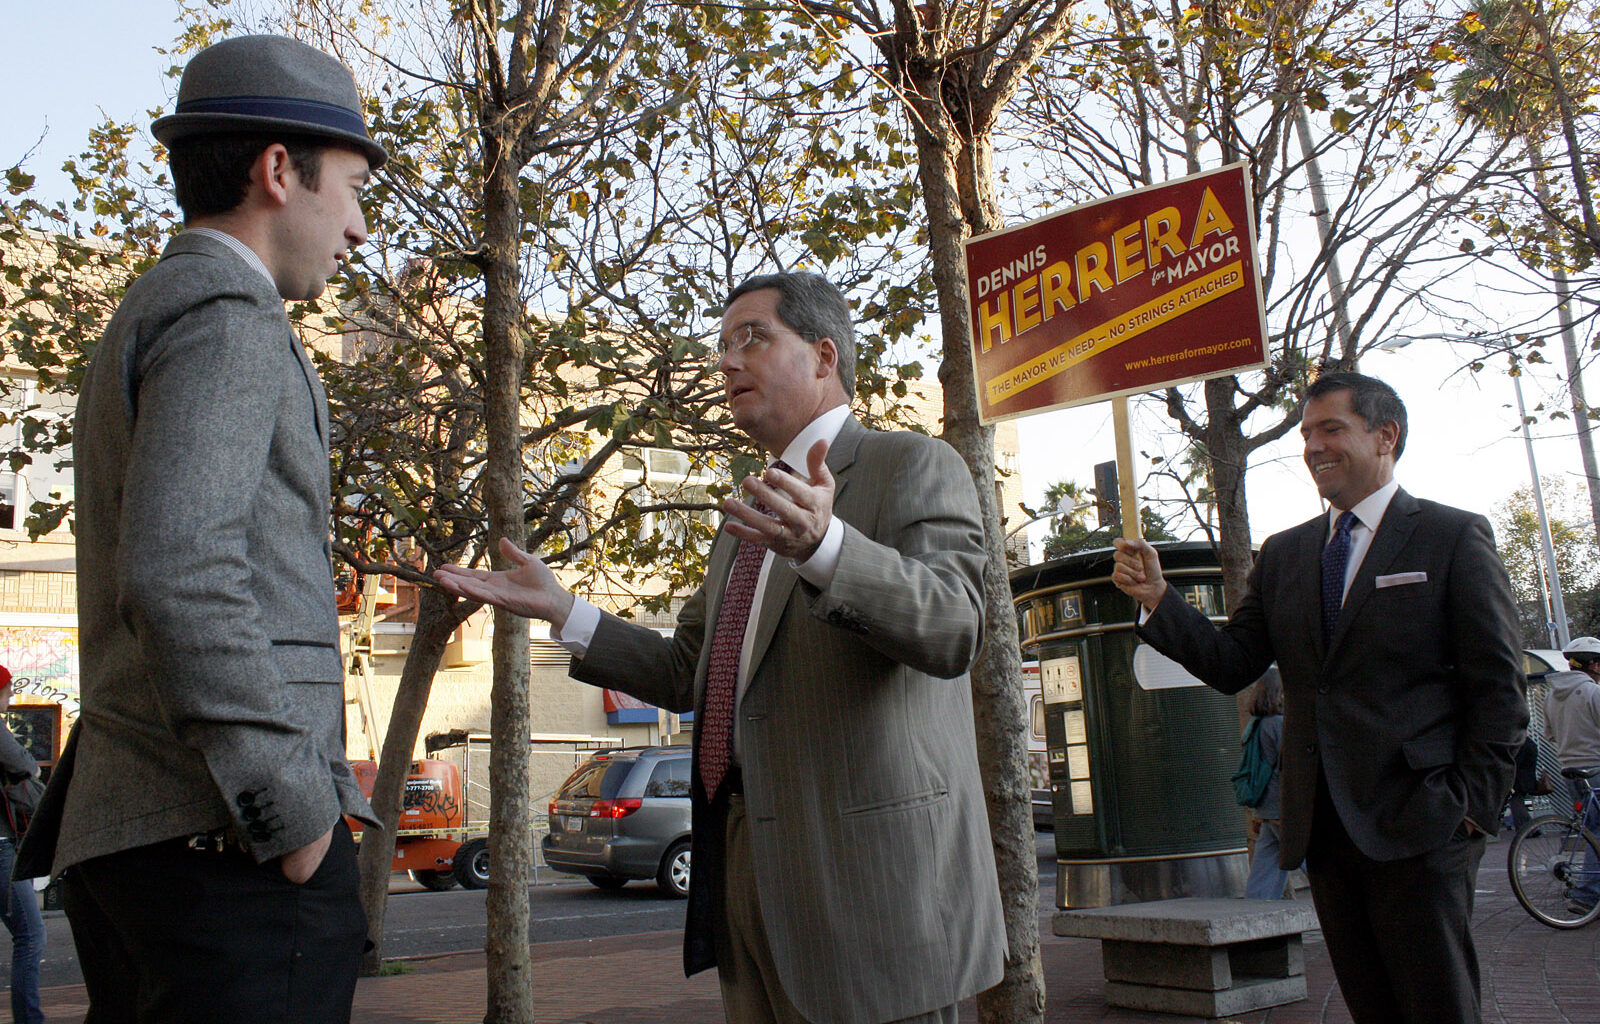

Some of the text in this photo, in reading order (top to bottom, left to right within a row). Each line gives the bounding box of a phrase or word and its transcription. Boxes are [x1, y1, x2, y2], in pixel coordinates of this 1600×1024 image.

[977, 245, 1047, 299] DENNIS
[978, 186, 1235, 354] HERRERA
[1151, 235, 1241, 287] for MAYOR
[991, 380, 1011, 396] THE
[1013, 361, 1048, 387] MAYOR
[1048, 352, 1066, 370] WE
[1067, 338, 1096, 359] NEED
[1109, 323, 1127, 339] NO
[1128, 300, 1176, 331] STRINGS
[1178, 271, 1239, 307] ATTACHED
[1125, 337, 1252, 371] www.herreraformayor.com
